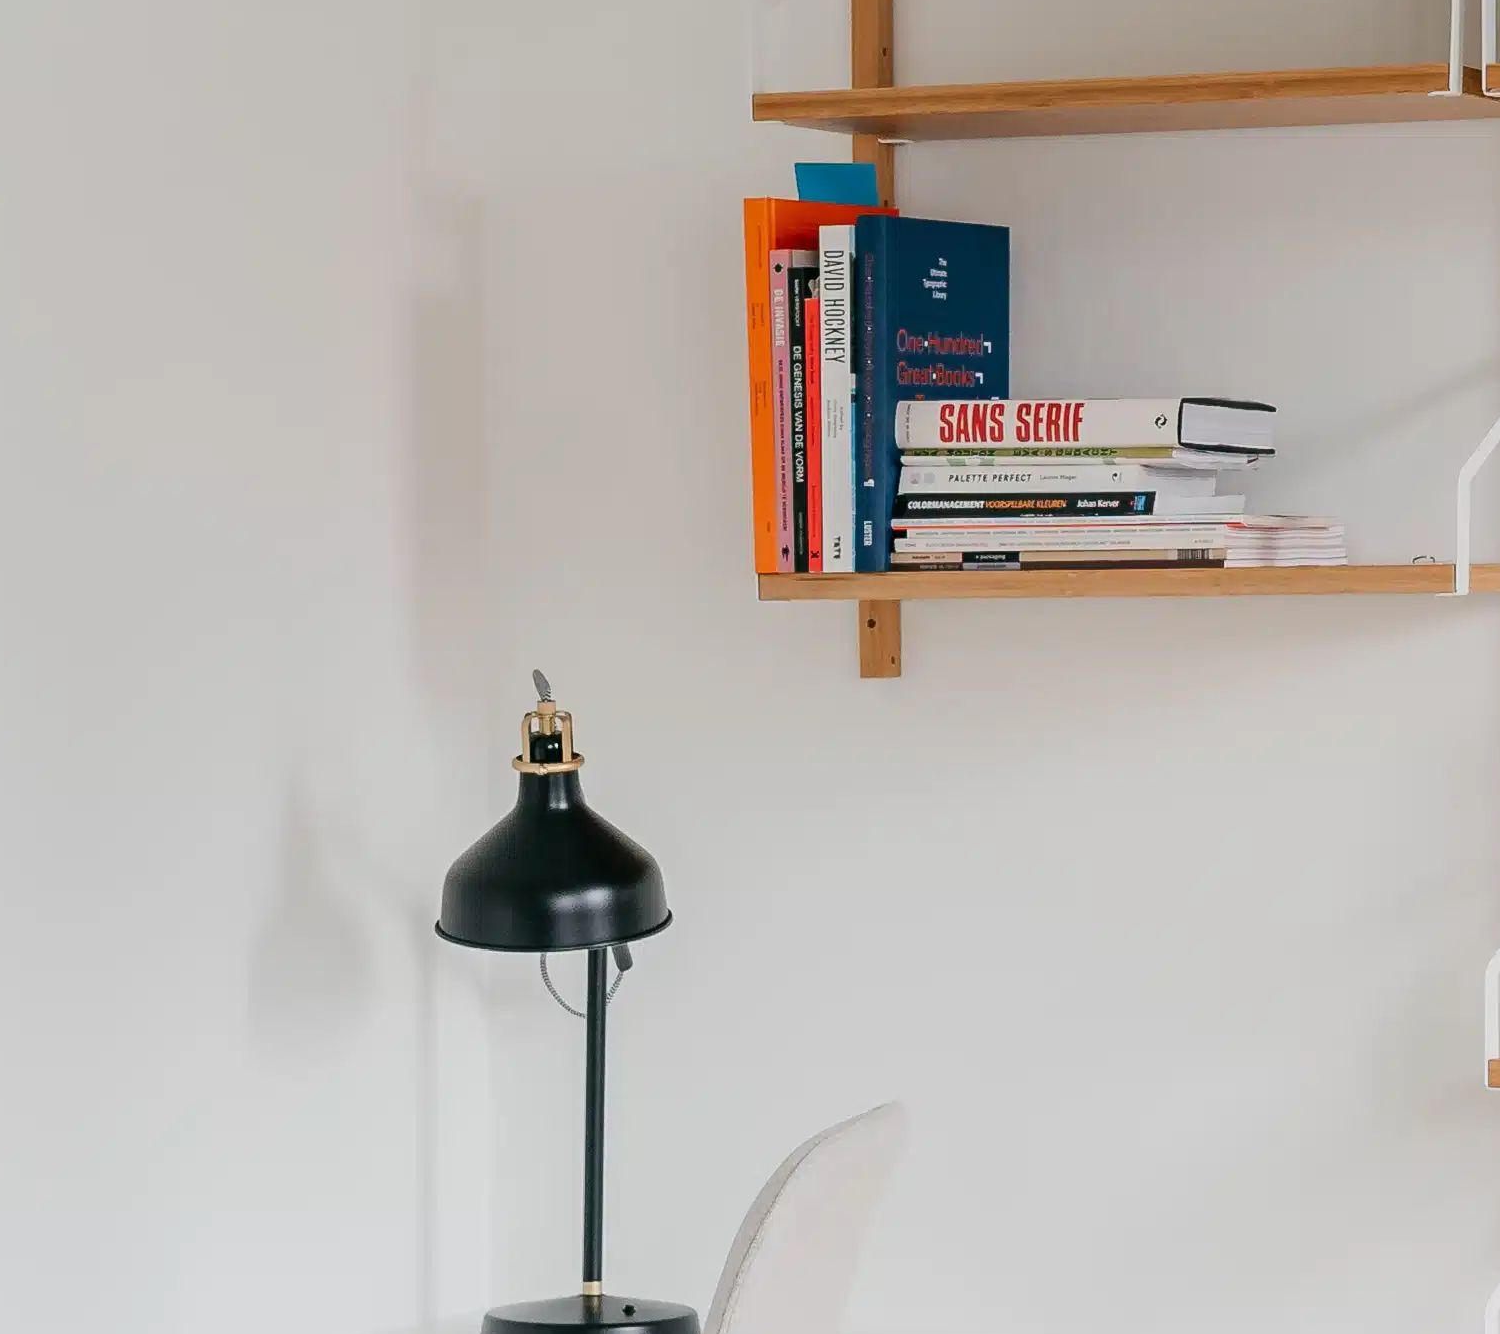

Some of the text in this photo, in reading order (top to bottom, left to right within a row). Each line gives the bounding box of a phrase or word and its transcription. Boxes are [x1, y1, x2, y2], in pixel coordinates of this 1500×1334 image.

[824, 250, 845, 364] DAVID HOCKNEY
[793, 346, 805, 483] DE GENESIS VAN DE VORM
[940, 403, 1085, 443] SANS SERIF
[949, 474, 1032, 483] PALETTE PERFECT
